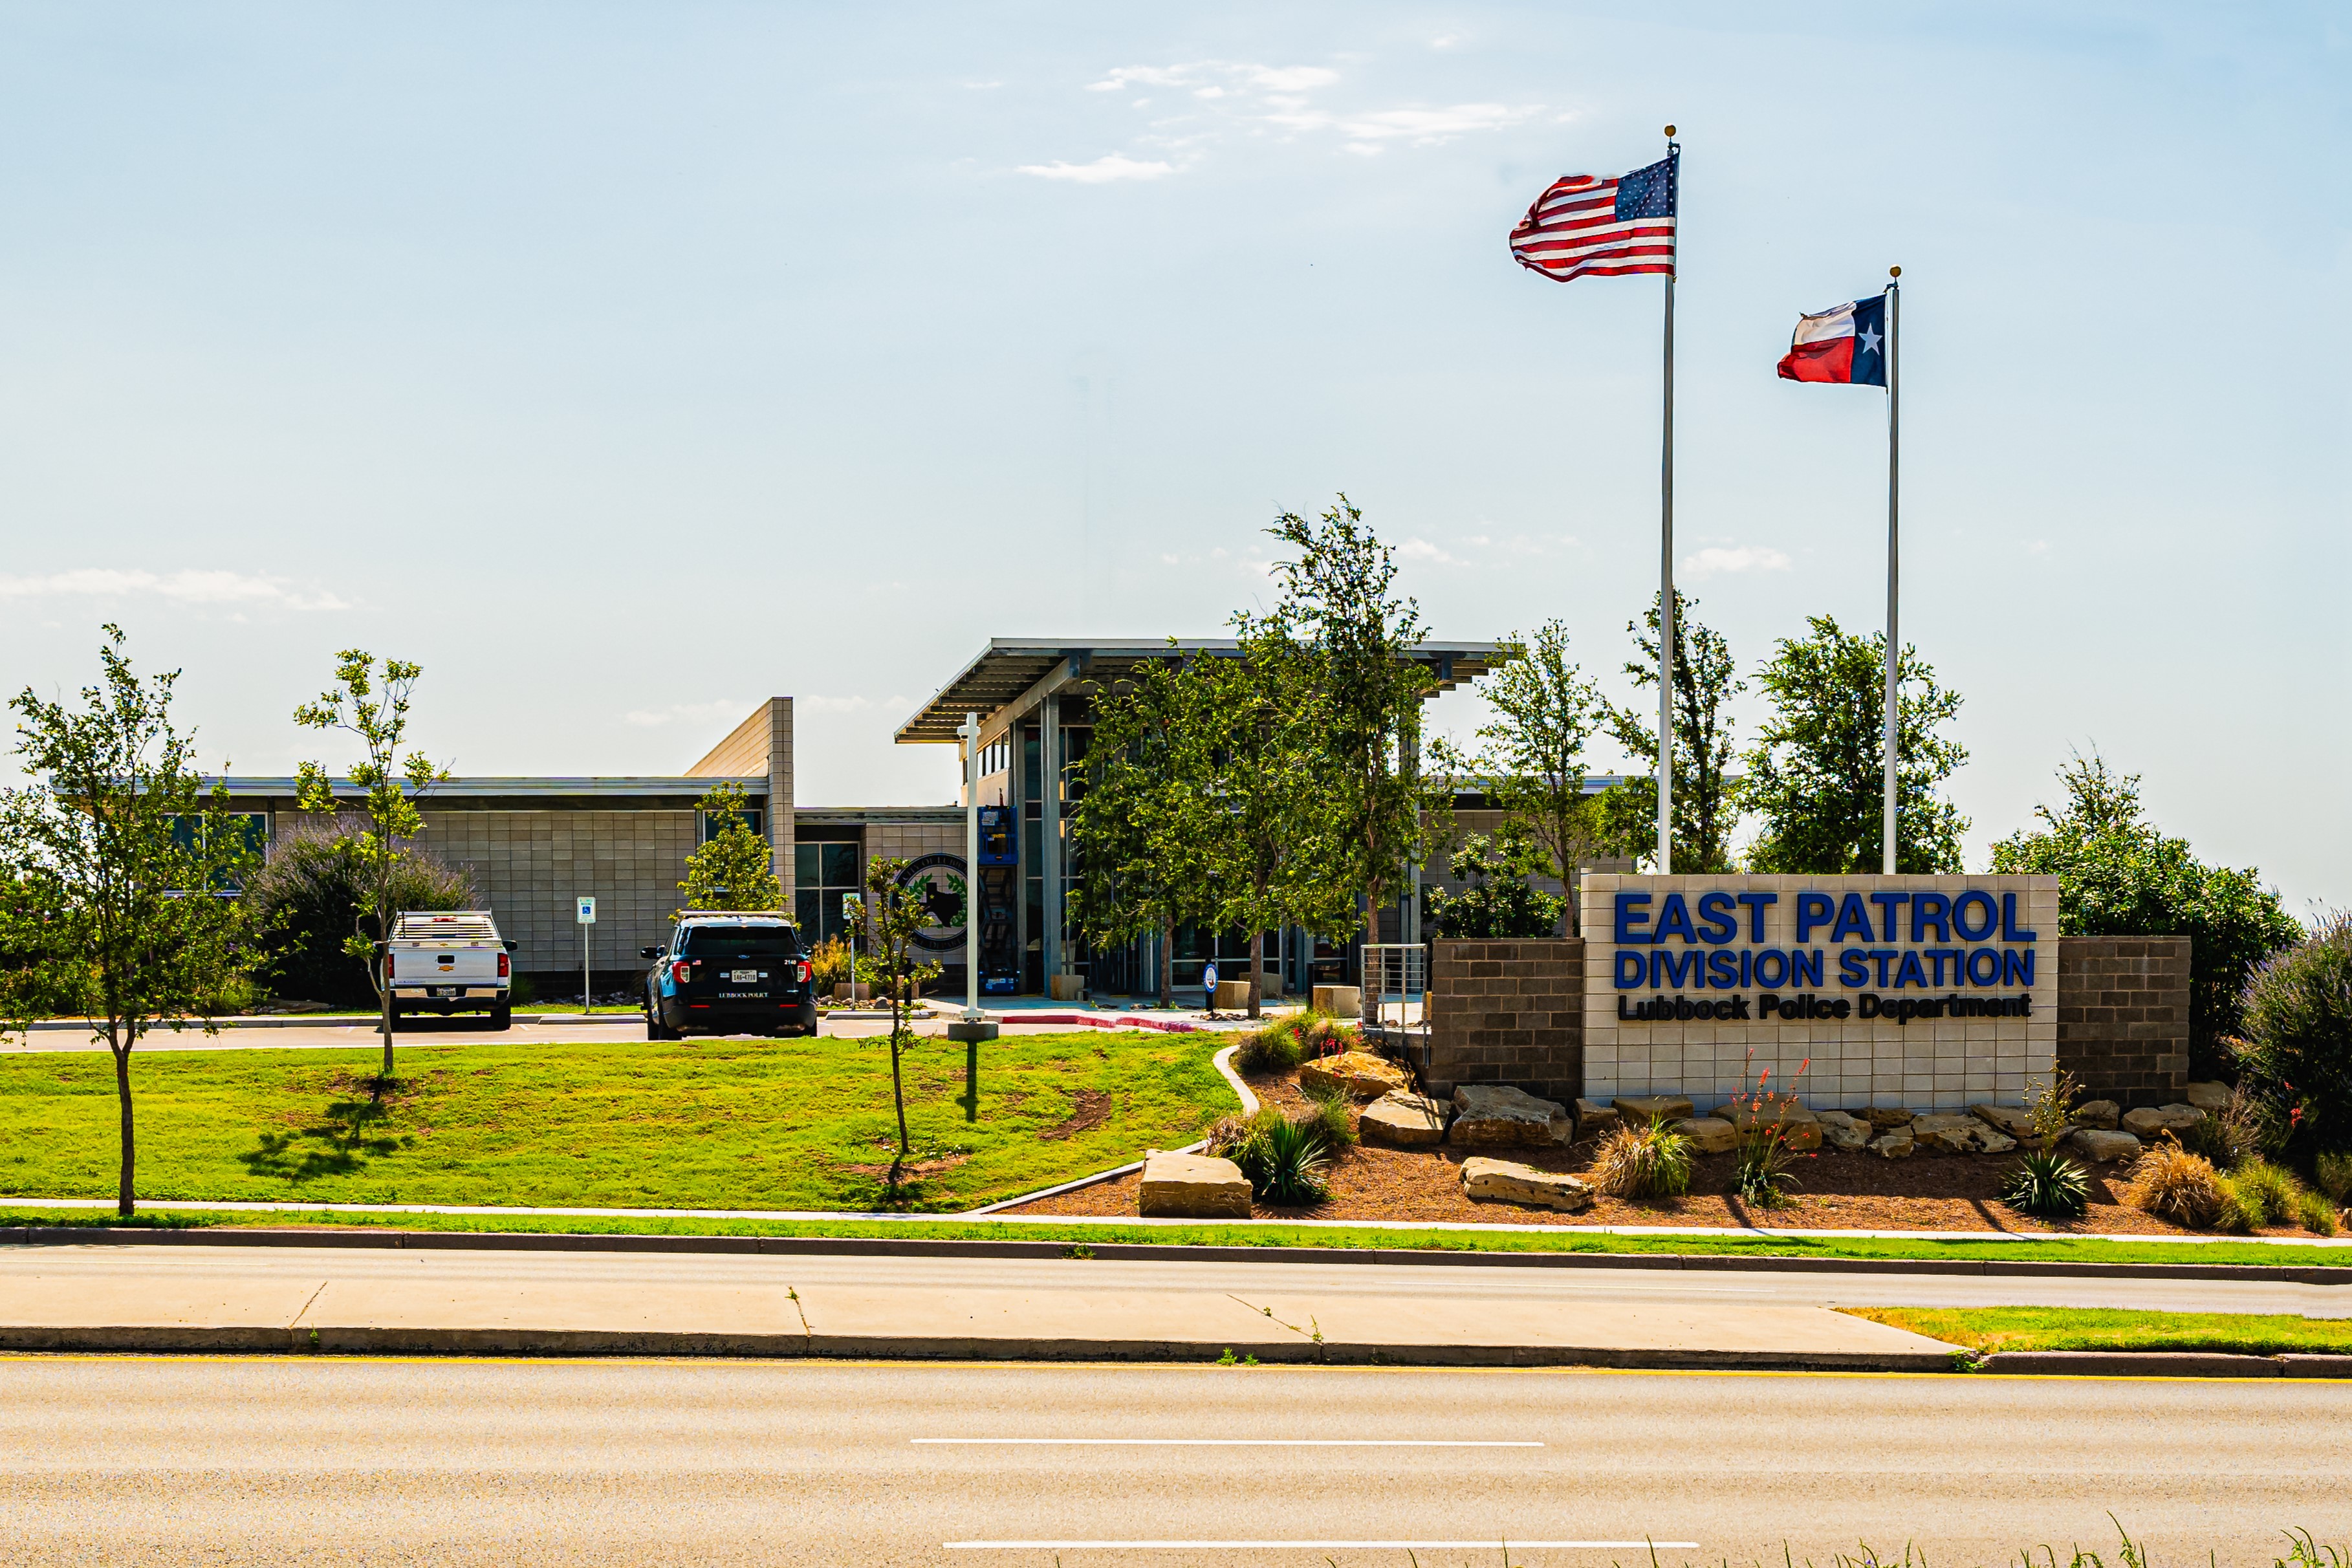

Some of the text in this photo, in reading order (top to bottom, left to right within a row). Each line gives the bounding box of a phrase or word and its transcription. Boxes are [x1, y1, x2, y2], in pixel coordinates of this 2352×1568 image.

[1614, 890, 2037, 945] EAST PATROL
[1614, 948, 2034, 989] DIVISION STATION
[1618, 993, 2032, 1025] Lubbock Police Department
